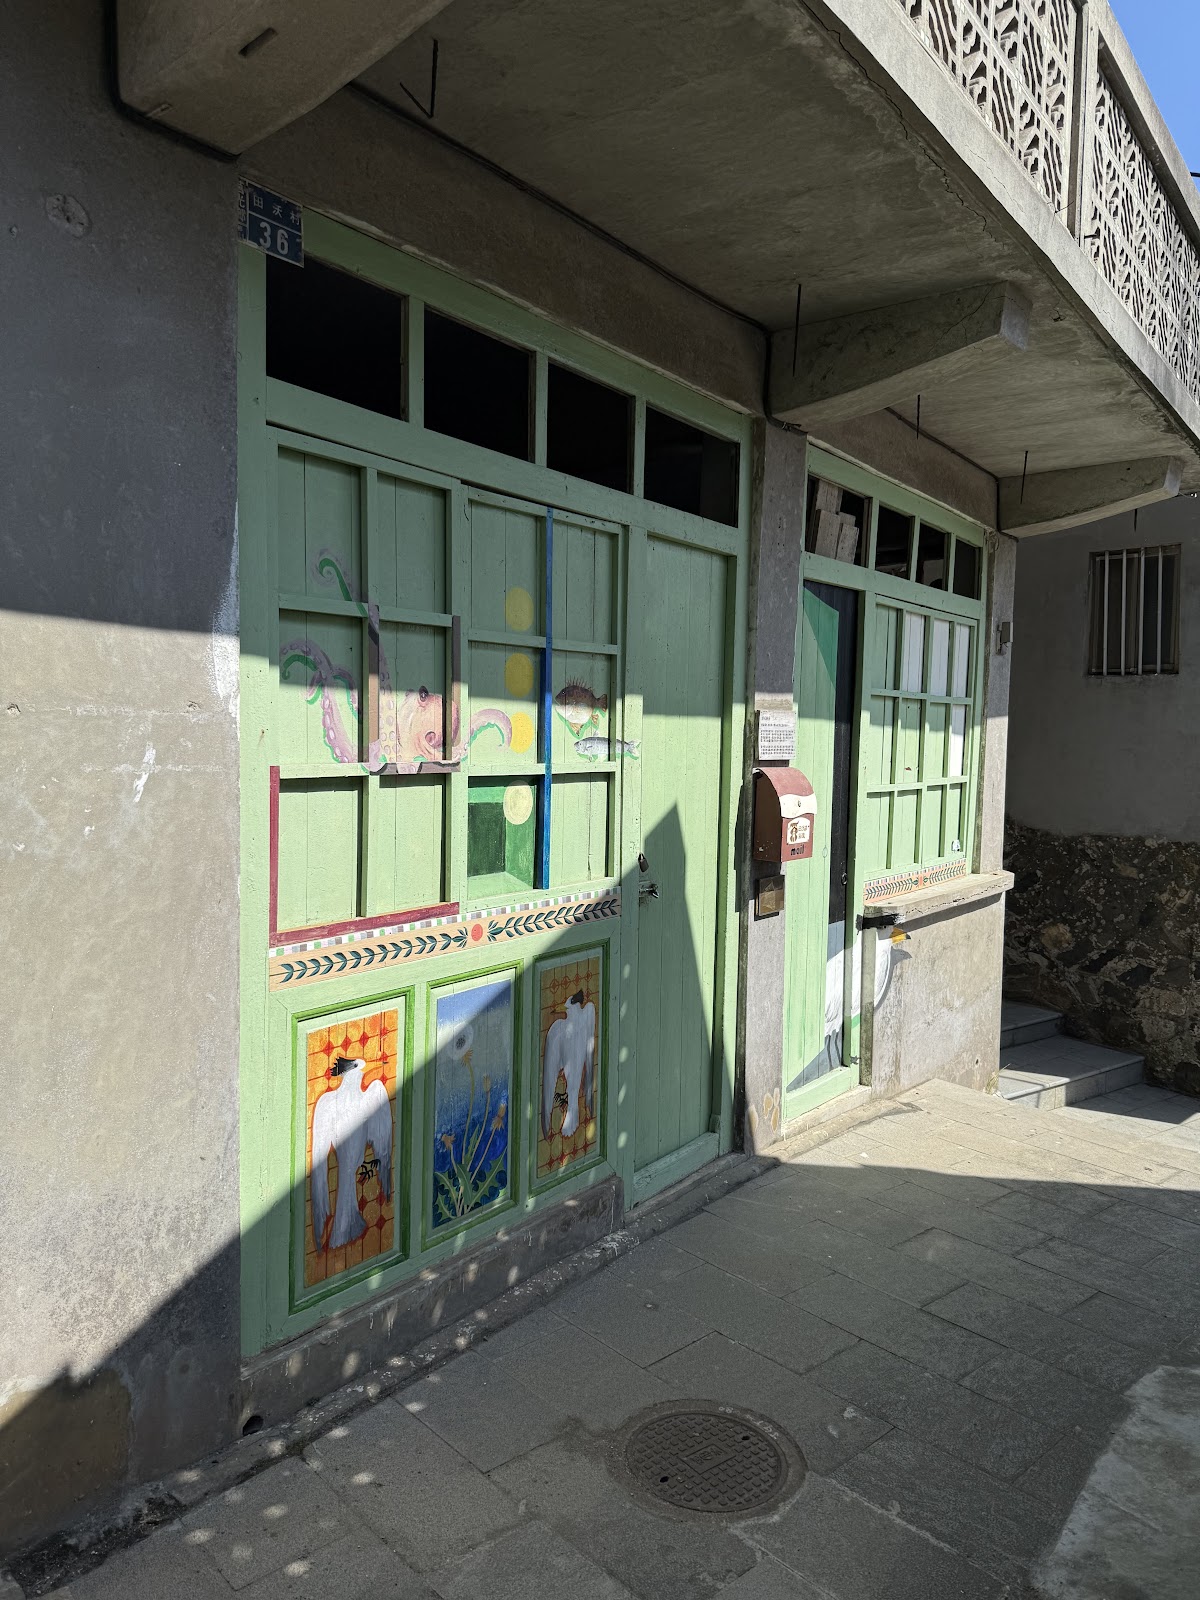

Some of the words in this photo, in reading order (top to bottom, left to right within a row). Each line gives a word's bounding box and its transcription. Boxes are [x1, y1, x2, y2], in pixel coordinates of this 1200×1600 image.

[253, 195, 300, 225] 田沃村
[259, 221, 289, 255] 36
[790, 844, 805, 856] mail
